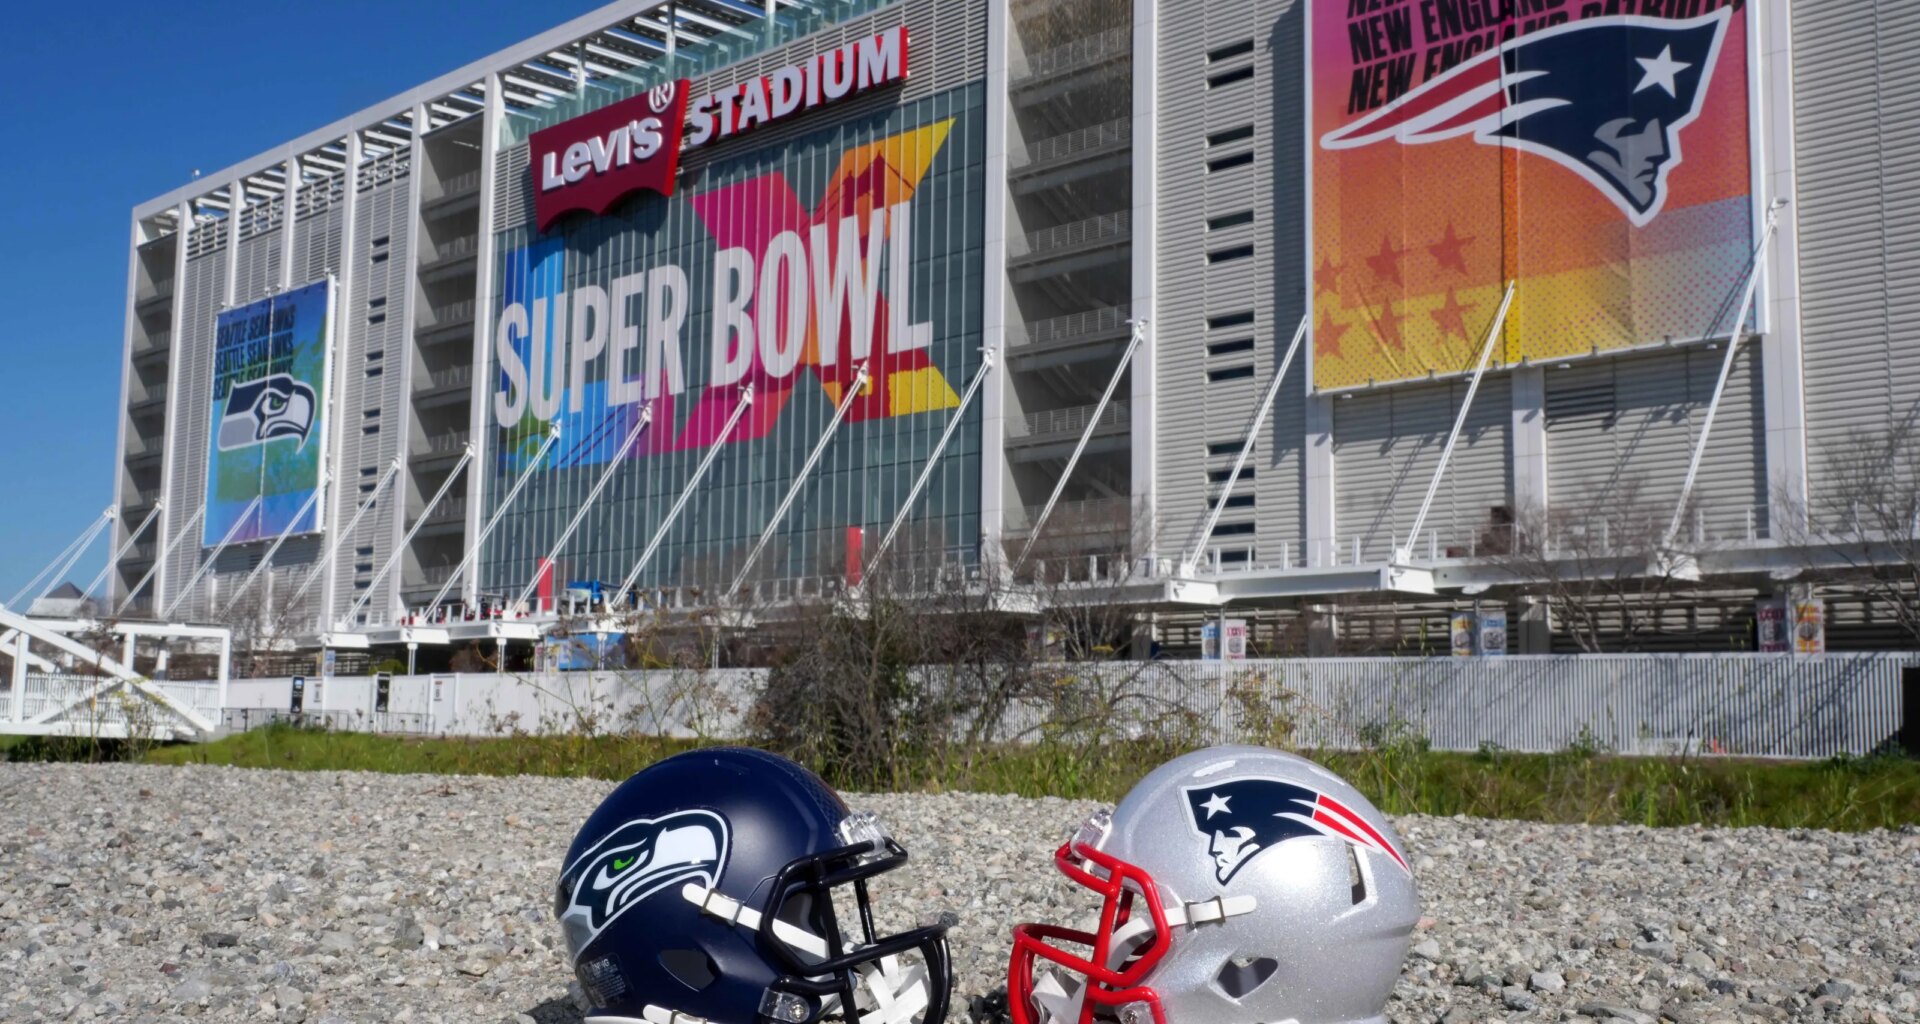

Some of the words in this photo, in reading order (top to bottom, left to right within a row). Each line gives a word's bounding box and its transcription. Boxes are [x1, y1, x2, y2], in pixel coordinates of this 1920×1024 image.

[1348, 6, 1413, 64] NEW
[689, 26, 906, 147] STADIUM
[1348, 53, 1417, 115] NEW
[494, 264, 689, 428] SUPER
[710, 201, 934, 388] BOWL
[215, 345, 245, 376] SEATTLE
